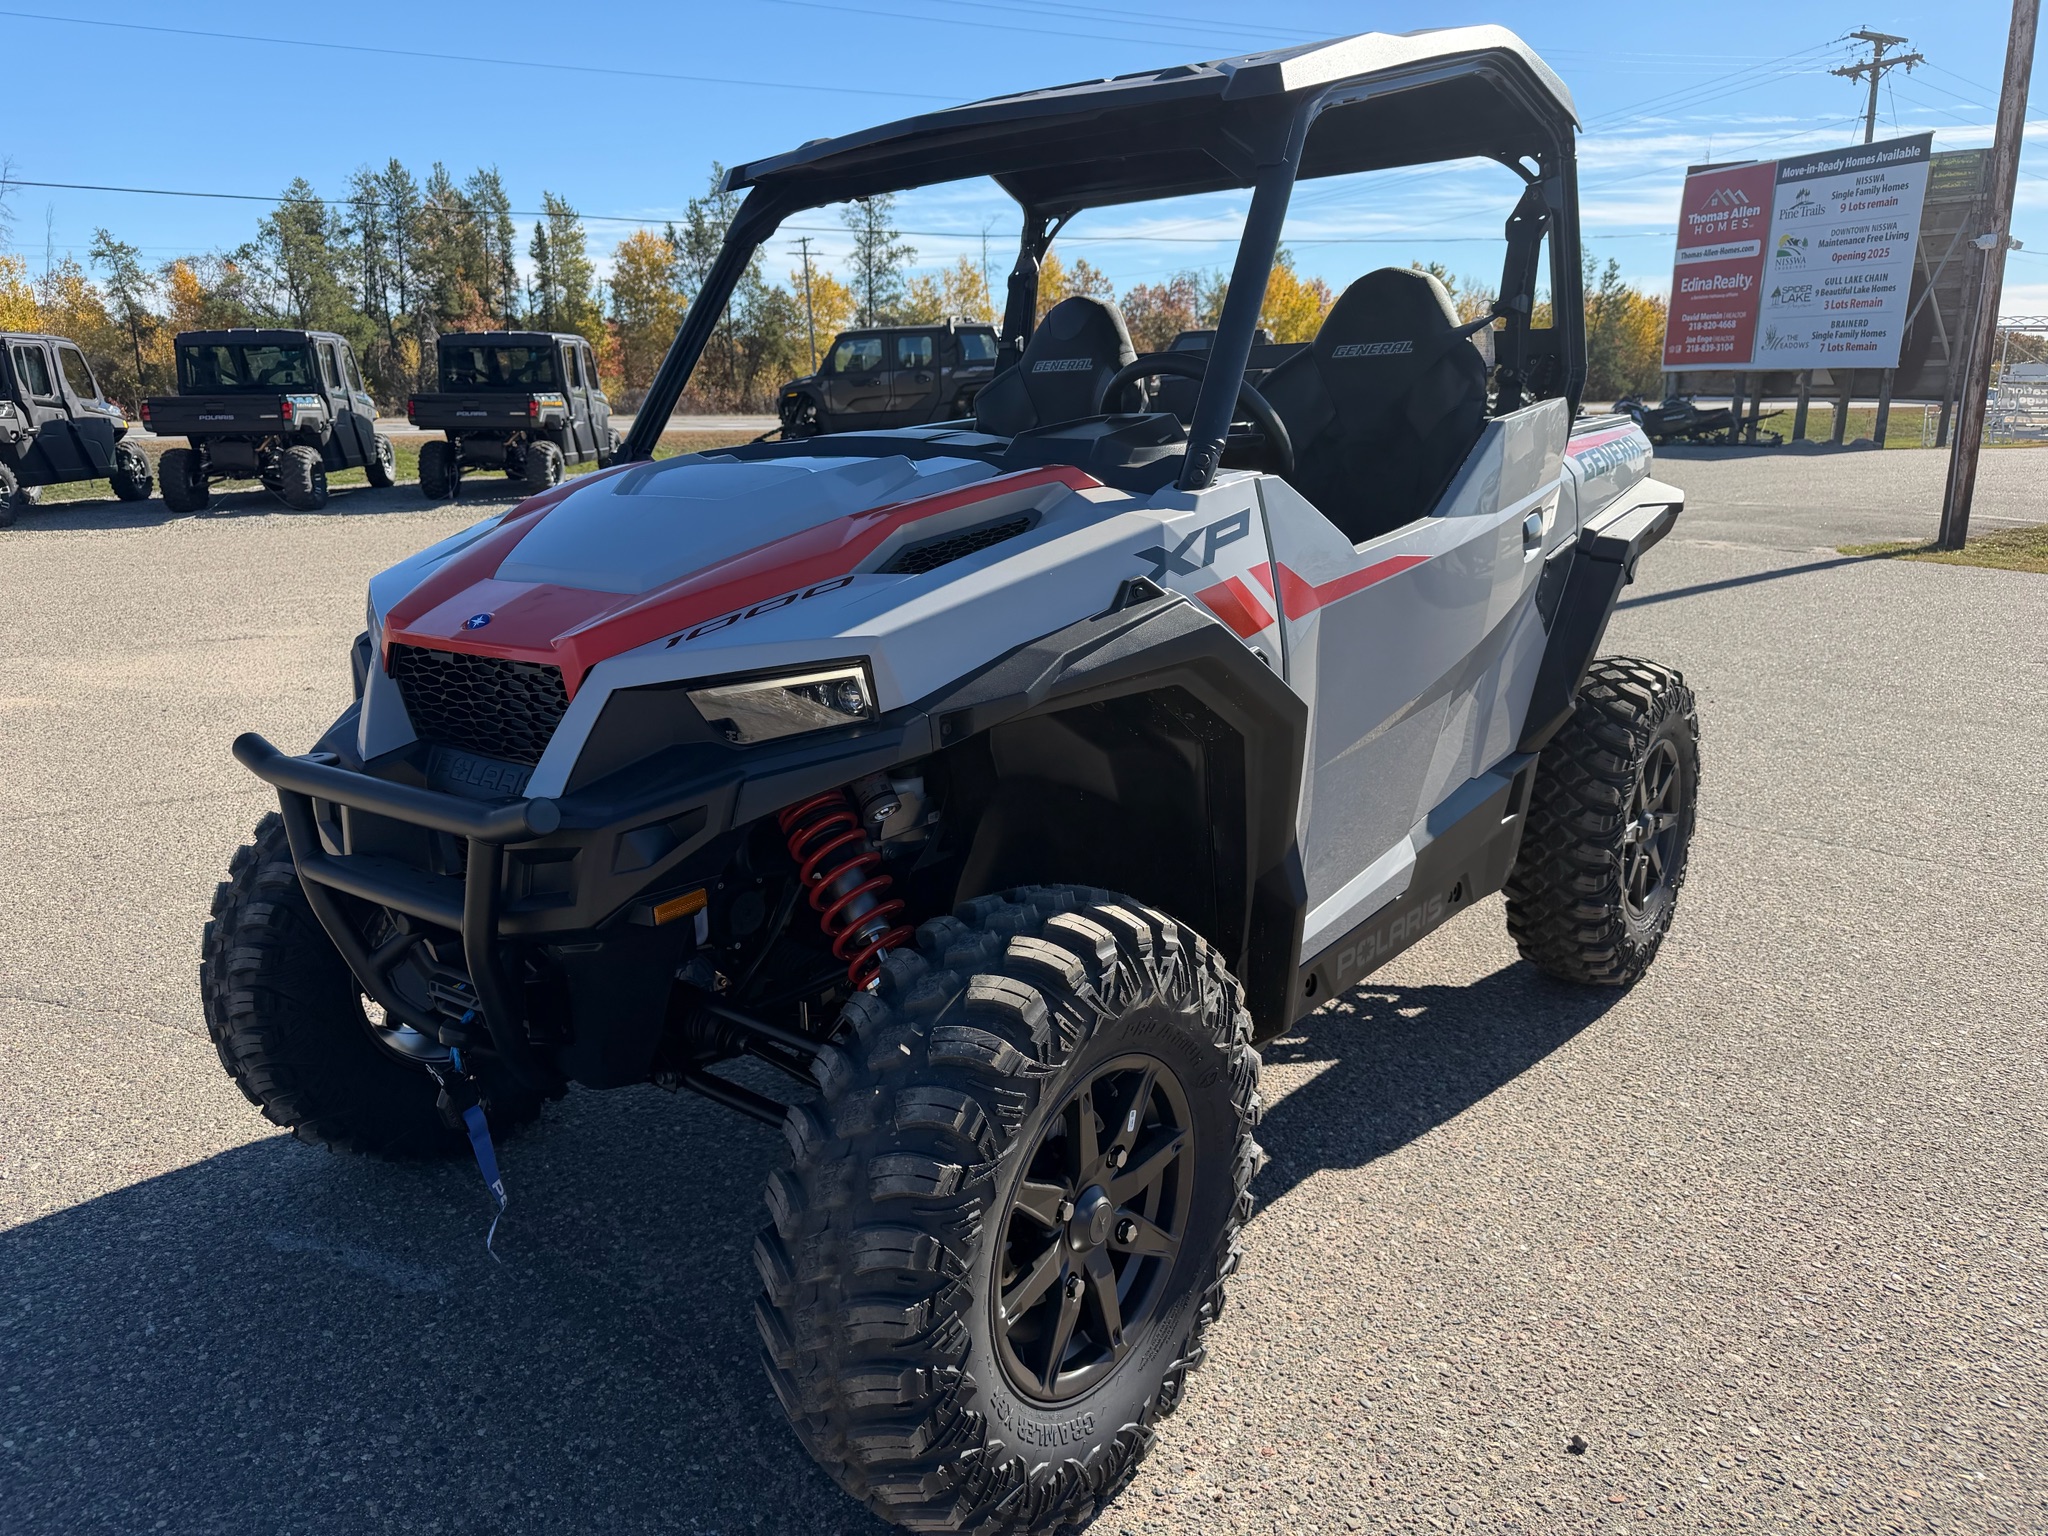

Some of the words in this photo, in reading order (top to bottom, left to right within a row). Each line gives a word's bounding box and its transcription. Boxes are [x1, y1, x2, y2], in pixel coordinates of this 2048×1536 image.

[1845, 155, 1875, 168] Homes
[1876, 145, 1921, 162] Available
[1856, 173, 1885, 186] NISSWA
[1831, 189, 1854, 200] Single
[1855, 185, 1881, 197] Family
[1882, 182, 1909, 193] Homes
[1779, 208, 1799, 220] Pine
[1799, 204, 1826, 218] Trails
[1840, 203, 1846, 213] 9
[1848, 200, 1866, 211] Lots
[1867, 196, 1899, 209] remain
[1688, 211, 1729, 225] Thomas
[1730, 206, 1760, 219] Allen
[1694, 218, 1749, 235] HOMES
[1831, 225, 1870, 236] DOWNTOWN
[1871, 222, 1898, 232] NISSWA
[1818, 235, 1865, 248] Maintenance
[1866, 233, 1884, 243] Free
[1885, 231, 1910, 241] Living
[1775, 256, 1806, 266] NISSWA
[1831, 250, 1866, 264] Opening
[1867, 247, 1890, 259] 2025
[1825, 277, 1842, 286] GULL
[1845, 274, 1863, 284] LAKE
[1864, 273, 1889, 282] CHAIN
[1782, 284, 1812, 294] SPIDER
[1815, 289, 1820, 297] 9
[1820, 286, 1853, 296] Beautiful
[1853, 285, 1870, 294] Lake
[1871, 284, 1896, 292] Homes
[1781, 292, 1812, 304] LAKE
[1824, 300, 1829, 310] 3
[1831, 299, 1848, 309] Lots
[1849, 296, 1883, 308] Remain
[1830, 319, 1869, 329] BRAINERD
[1811, 331, 1834, 341] Single
[1834, 329, 1859, 340] Family
[1860, 329, 1887, 338] Homes
[1332, 340, 1413, 358] GENERAL
[1820, 343, 1826, 353] 7
[1827, 342, 1844, 352] Lots
[1845, 341, 1878, 351] Remain
[1031, 358, 1093, 373] GENERAL
[1574, 435, 1648, 482] GENERAL
[1133, 507, 1251, 583] XP
[664, 576, 855, 649] 1000
[1336, 893, 1444, 980] POLARIS
